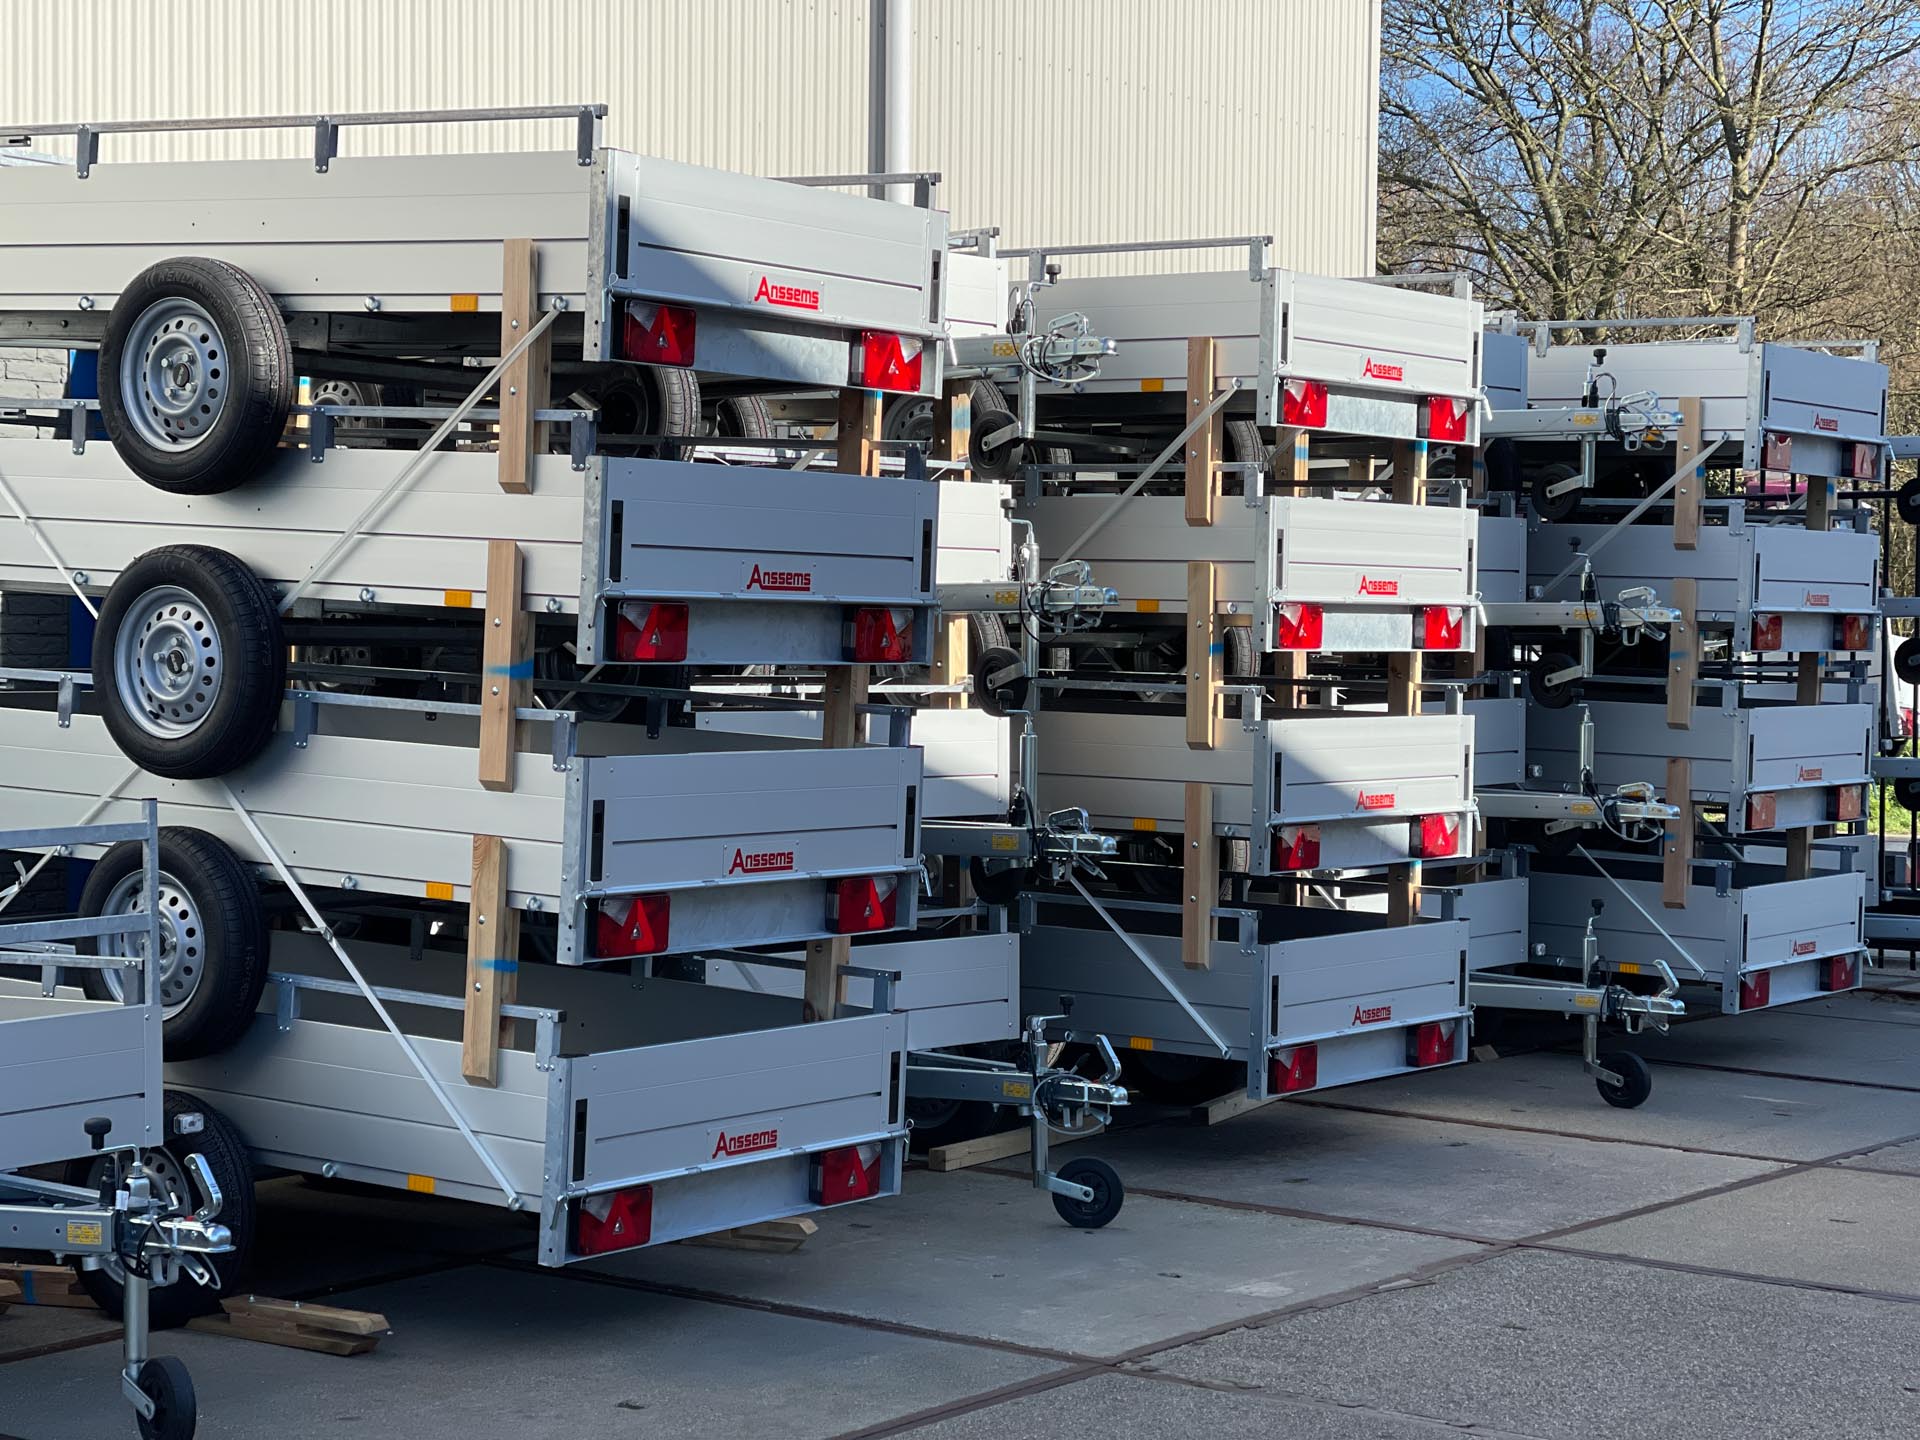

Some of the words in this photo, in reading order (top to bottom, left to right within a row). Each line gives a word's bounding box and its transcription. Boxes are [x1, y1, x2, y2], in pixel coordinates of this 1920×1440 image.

[754, 276, 819, 310] Anssems
[1363, 357, 1403, 381] Anssems
[747, 564, 810, 591] Anssems
[1358, 575, 1398, 595] Anssems
[1355, 791, 1394, 810] Anssems
[729, 848, 794, 875] Anssems
[1352, 1005, 1391, 1026] Anssems
[712, 1129, 777, 1159] Anssems
